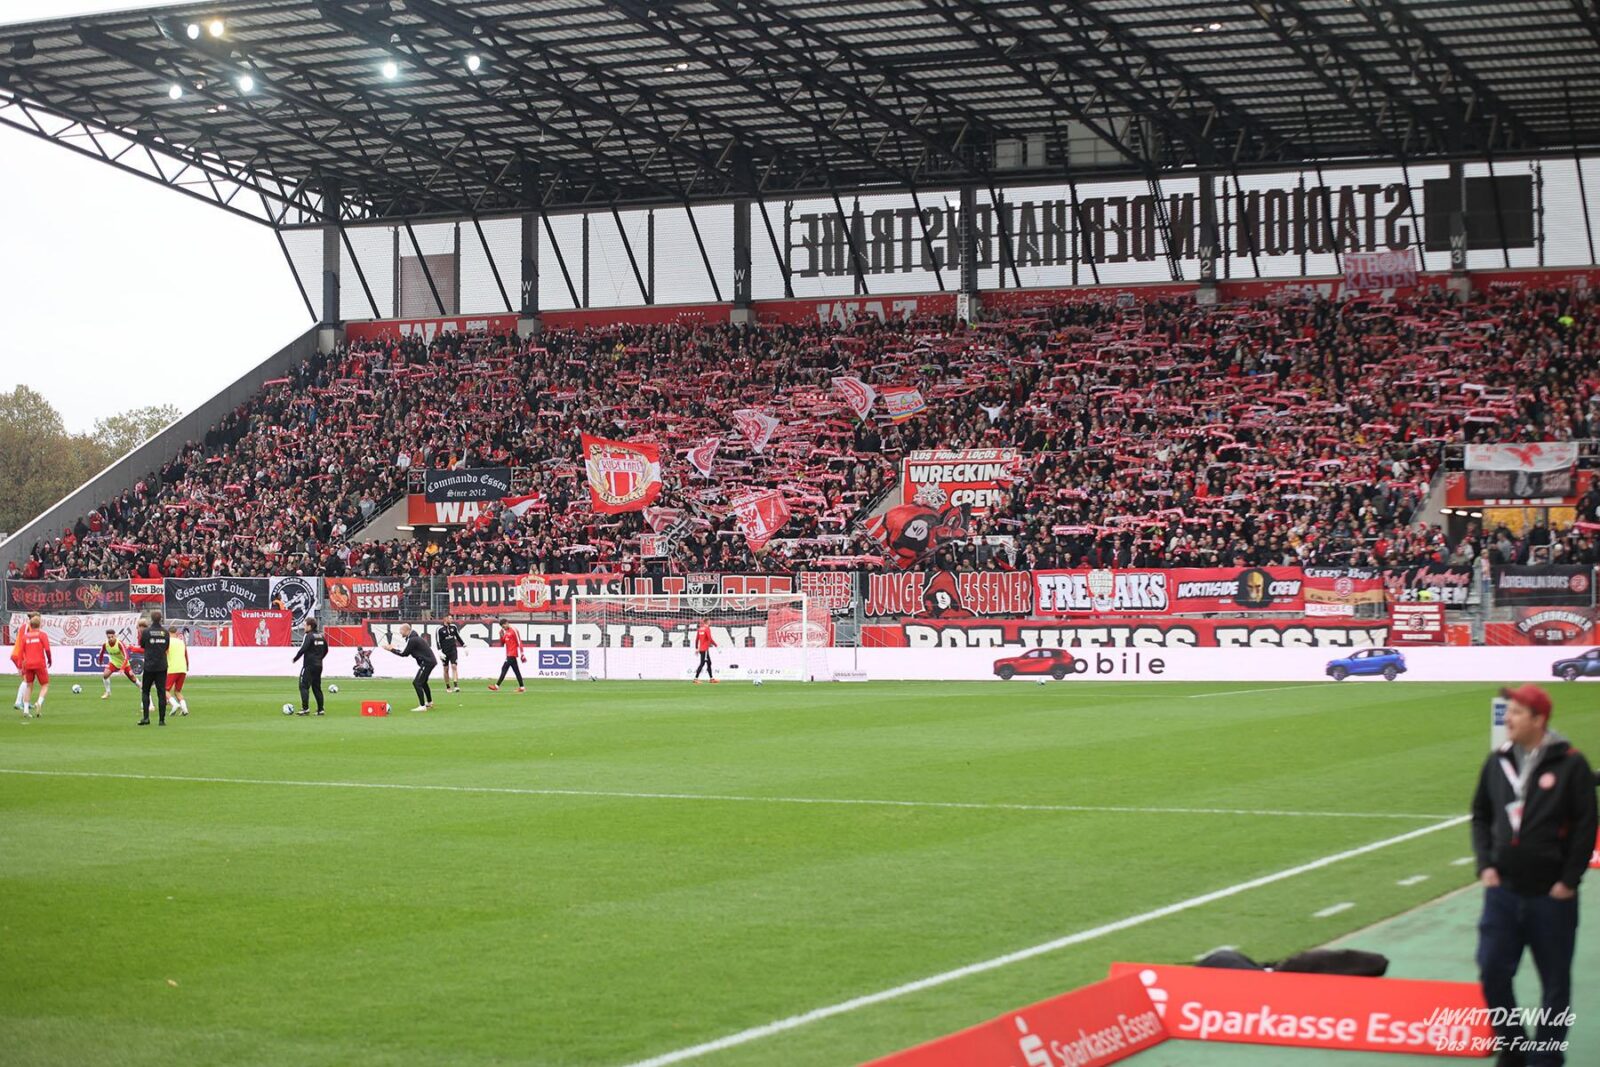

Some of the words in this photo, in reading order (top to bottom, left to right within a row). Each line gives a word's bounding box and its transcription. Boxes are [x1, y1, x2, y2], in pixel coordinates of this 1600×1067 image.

[1200, 247, 1213, 259] W
[1452, 251, 1463, 264] 3
[733, 269, 746, 281] W
[1201, 260, 1212, 274] 2
[1346, 271, 1416, 290] KASTEN
[913, 451, 932, 460] LOS
[966, 450, 998, 459] LOCOS
[427, 474, 478, 492] Commando
[480, 474, 508, 491] Essen
[469, 489, 487, 497] 2012
[76, 585, 125, 602] Esen
[175, 582, 218, 601] Essener
[220, 579, 257, 602] Löwen
[453, 580, 516, 607] RUDE
[550, 578, 622, 605] FANS
[865, 571, 925, 616] JUNGE
[959, 571, 1033, 615] ESSENER
[1177, 580, 1240, 598] NORTHSIDE
[1268, 580, 1302, 596] CREW
[357, 594, 398, 608] ESSEN
[806, 597, 851, 608] ERBOT
[204, 606, 227, 618] 1980
[1216, 627, 1388, 647] ESSEN
[1179, 1001, 1355, 1041] Sparkasse
[1365, 1012, 1472, 1046] Essen
[1052, 1028, 1126, 1067] Sparkasse
[1117, 1010, 1163, 1043] Essen
